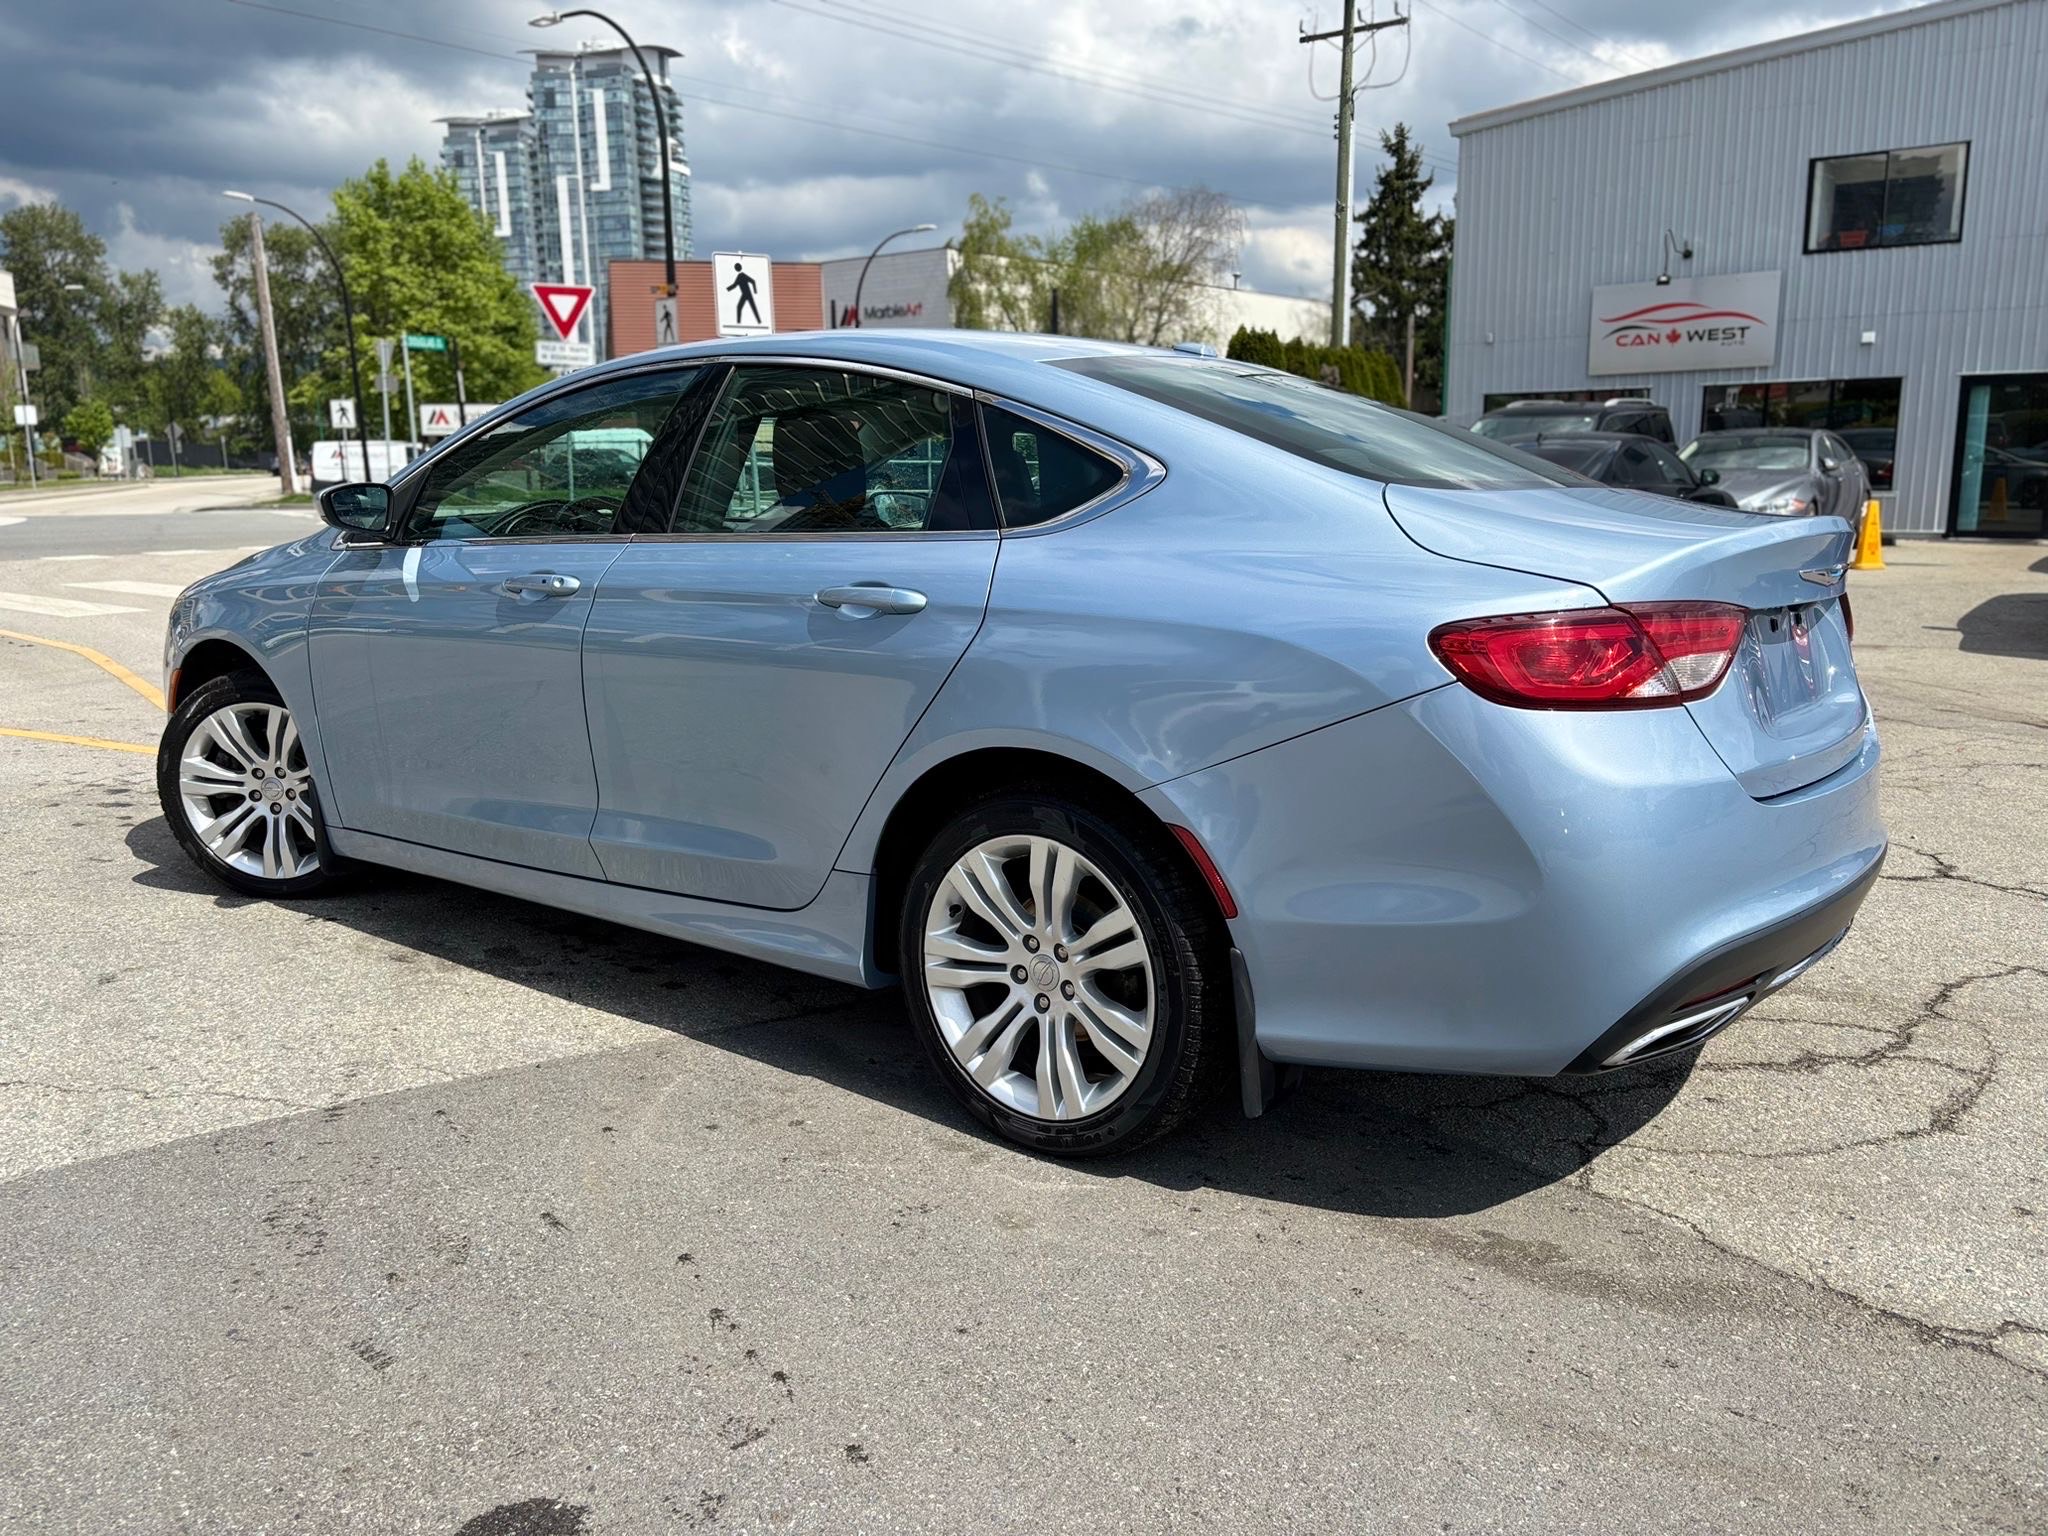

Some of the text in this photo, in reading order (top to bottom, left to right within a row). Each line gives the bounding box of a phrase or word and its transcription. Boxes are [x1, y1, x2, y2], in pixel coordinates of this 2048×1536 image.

[864, 302, 923, 319] MarbleArt
[1615, 326, 1751, 347] CAN WEST
